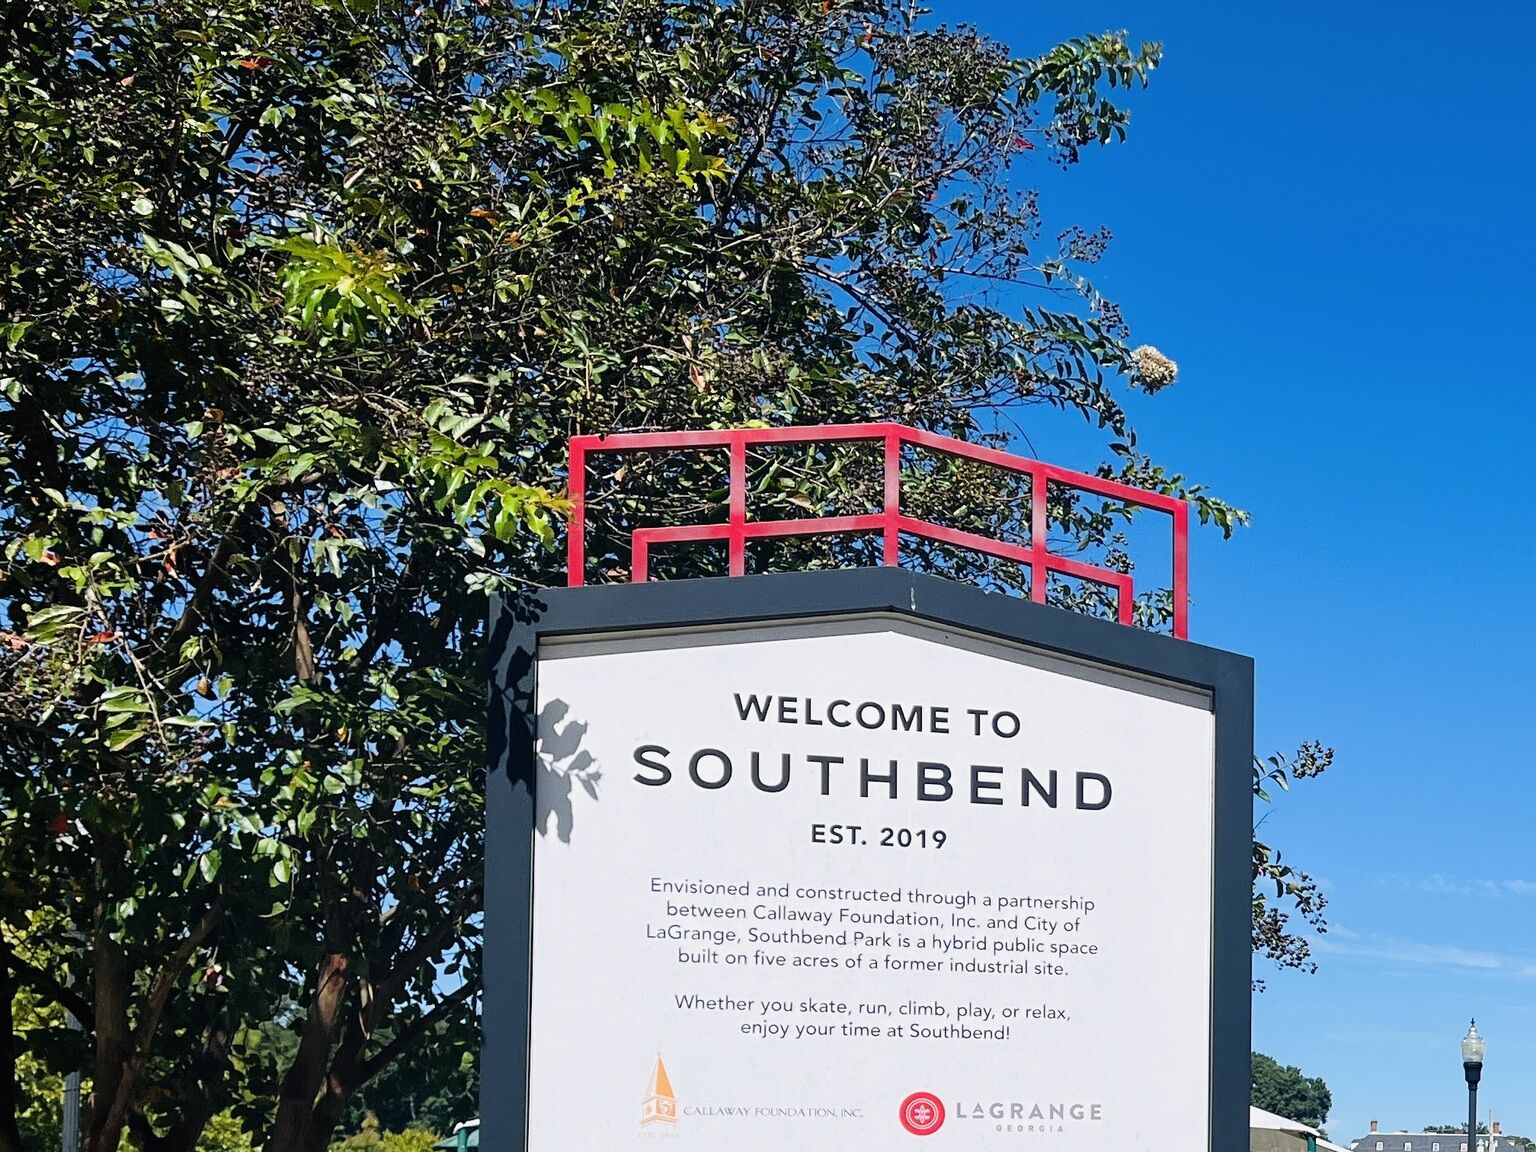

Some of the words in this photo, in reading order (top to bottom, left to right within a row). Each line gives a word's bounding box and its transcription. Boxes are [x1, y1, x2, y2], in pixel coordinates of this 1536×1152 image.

[733, 692, 950, 735] WELCOME
[966, 708, 1021, 738] TO
[632, 744, 1113, 811] SOUTHBEND
[811, 823, 867, 846] EST.
[879, 826, 947, 850] 2019
[650, 877, 750, 897] Envisioned
[756, 882, 790, 898] and
[795, 887, 902, 903] constructed
[906, 887, 977, 910] through
[982, 895, 992, 907] a
[997, 891, 1097, 916] partnership
[666, 900, 747, 919] between
[752, 902, 833, 926] Callaway
[839, 907, 945, 929] Foundation,
[950, 912, 981, 930] Inc.
[987, 914, 1019, 932] and
[1023, 915, 1058, 937] City
[1063, 916, 1082, 934] of
[645, 923, 741, 946] LaGrange,
[747, 927, 847, 947] Southbend
[852, 931, 892, 949] Park
[897, 932, 911, 948] is
[916, 937, 926, 949] a
[932, 933, 987, 956] hybrid
[992, 936, 1045, 958] public
[1049, 943, 1099, 959] space
[678, 947, 719, 964] built
[724, 953, 748, 965] on
[753, 949, 787, 967] five
[792, 956, 839, 968] acres
[844, 953, 863, 969] of
[868, 958, 878, 970] a
[883, 953, 944, 971] former
[949, 957, 1028, 975] industrial
[1034, 960, 1069, 976] site.
[674, 993, 755, 1011] Whether
[760, 1001, 794, 1022] you
[799, 996, 853, 1016] skate,
[858, 1003, 893, 1017] run,
[898, 999, 951, 1019] climb,
[956, 1001, 996, 1022] play,
[1002, 1007, 1021, 1019] or
[1025, 1003, 1071, 1022] relax,
[740, 1019, 790, 1040] enjoy
[795, 1024, 836, 1040] your
[840, 1021, 881, 1037] time
[886, 1024, 904, 1038] at
[909, 1022, 1010, 1040] Southbend!
[683, 1106, 751, 1117] CALLAWAY
[754, 1106, 838, 1119] FOUNDATION,
[840, 1108, 864, 1118] INC.
[995, 1124, 1064, 1133] GEORGIA
